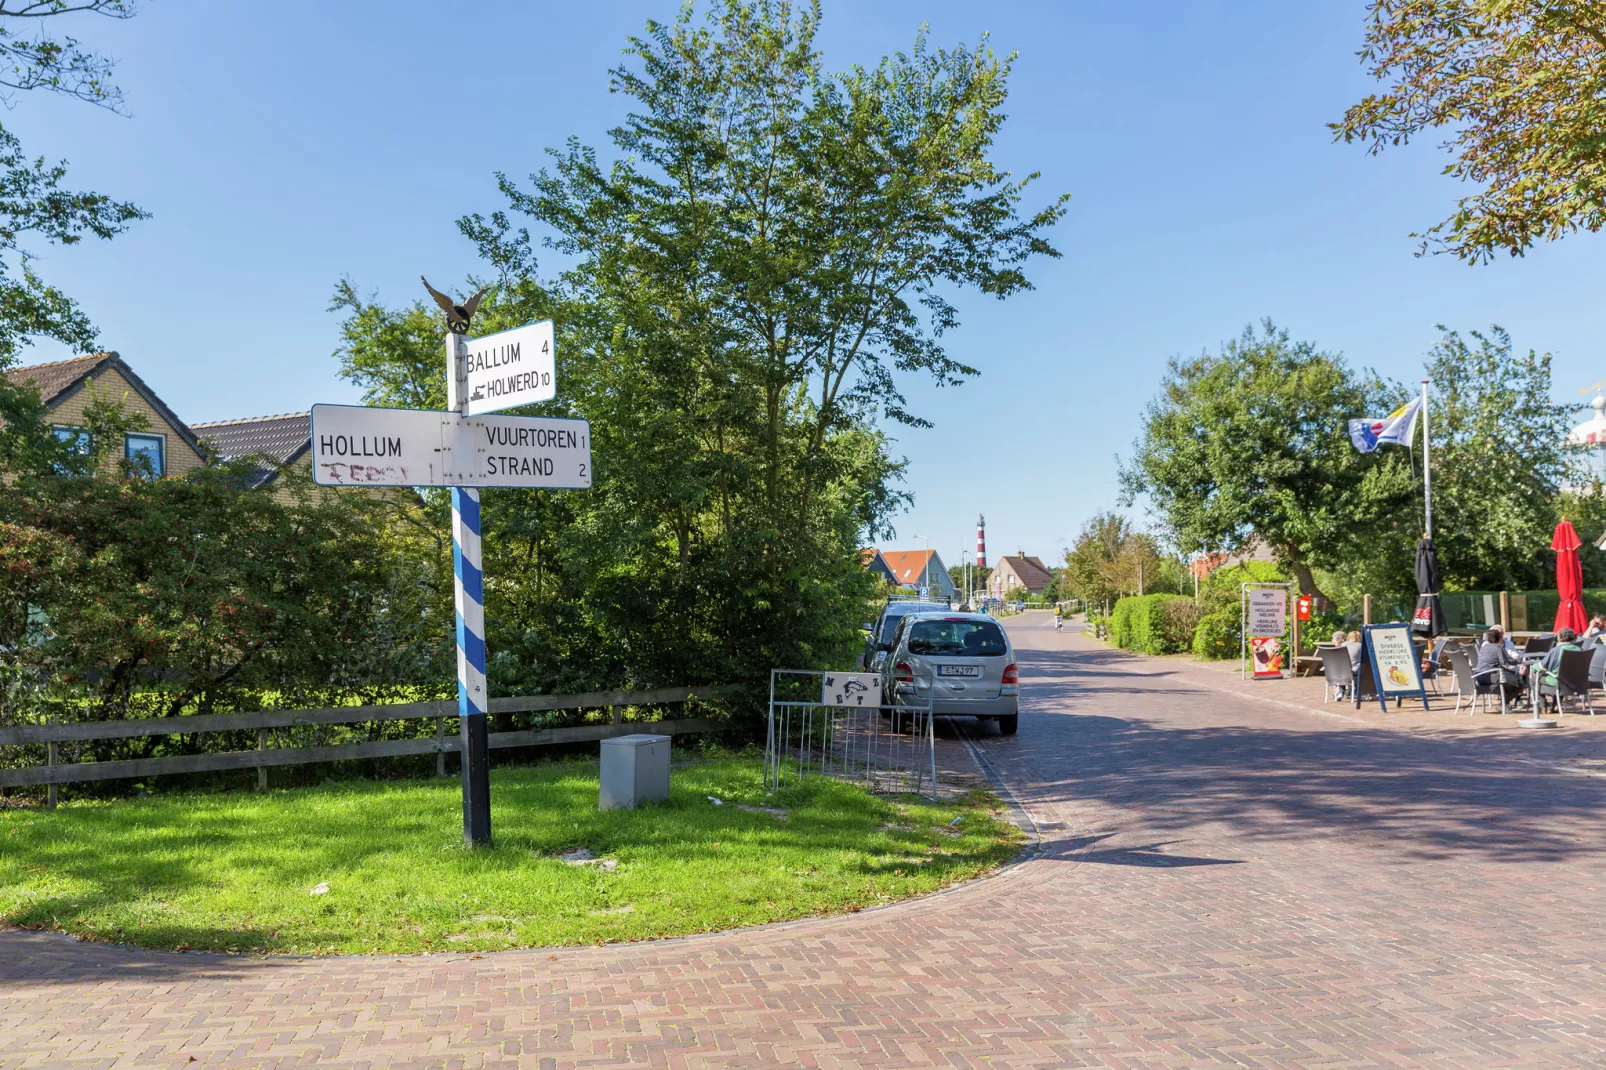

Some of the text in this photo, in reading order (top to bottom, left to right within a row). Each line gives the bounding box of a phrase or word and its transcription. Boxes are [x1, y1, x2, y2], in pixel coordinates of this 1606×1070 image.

[467, 340, 549, 373] BALLUM 4
[487, 370, 550, 398] HOLWERD 10
[321, 435, 402, 457] HOLLUM
[486, 426, 585, 449] VUURTOREN 1
[487, 456, 587, 477] STRAND 2
